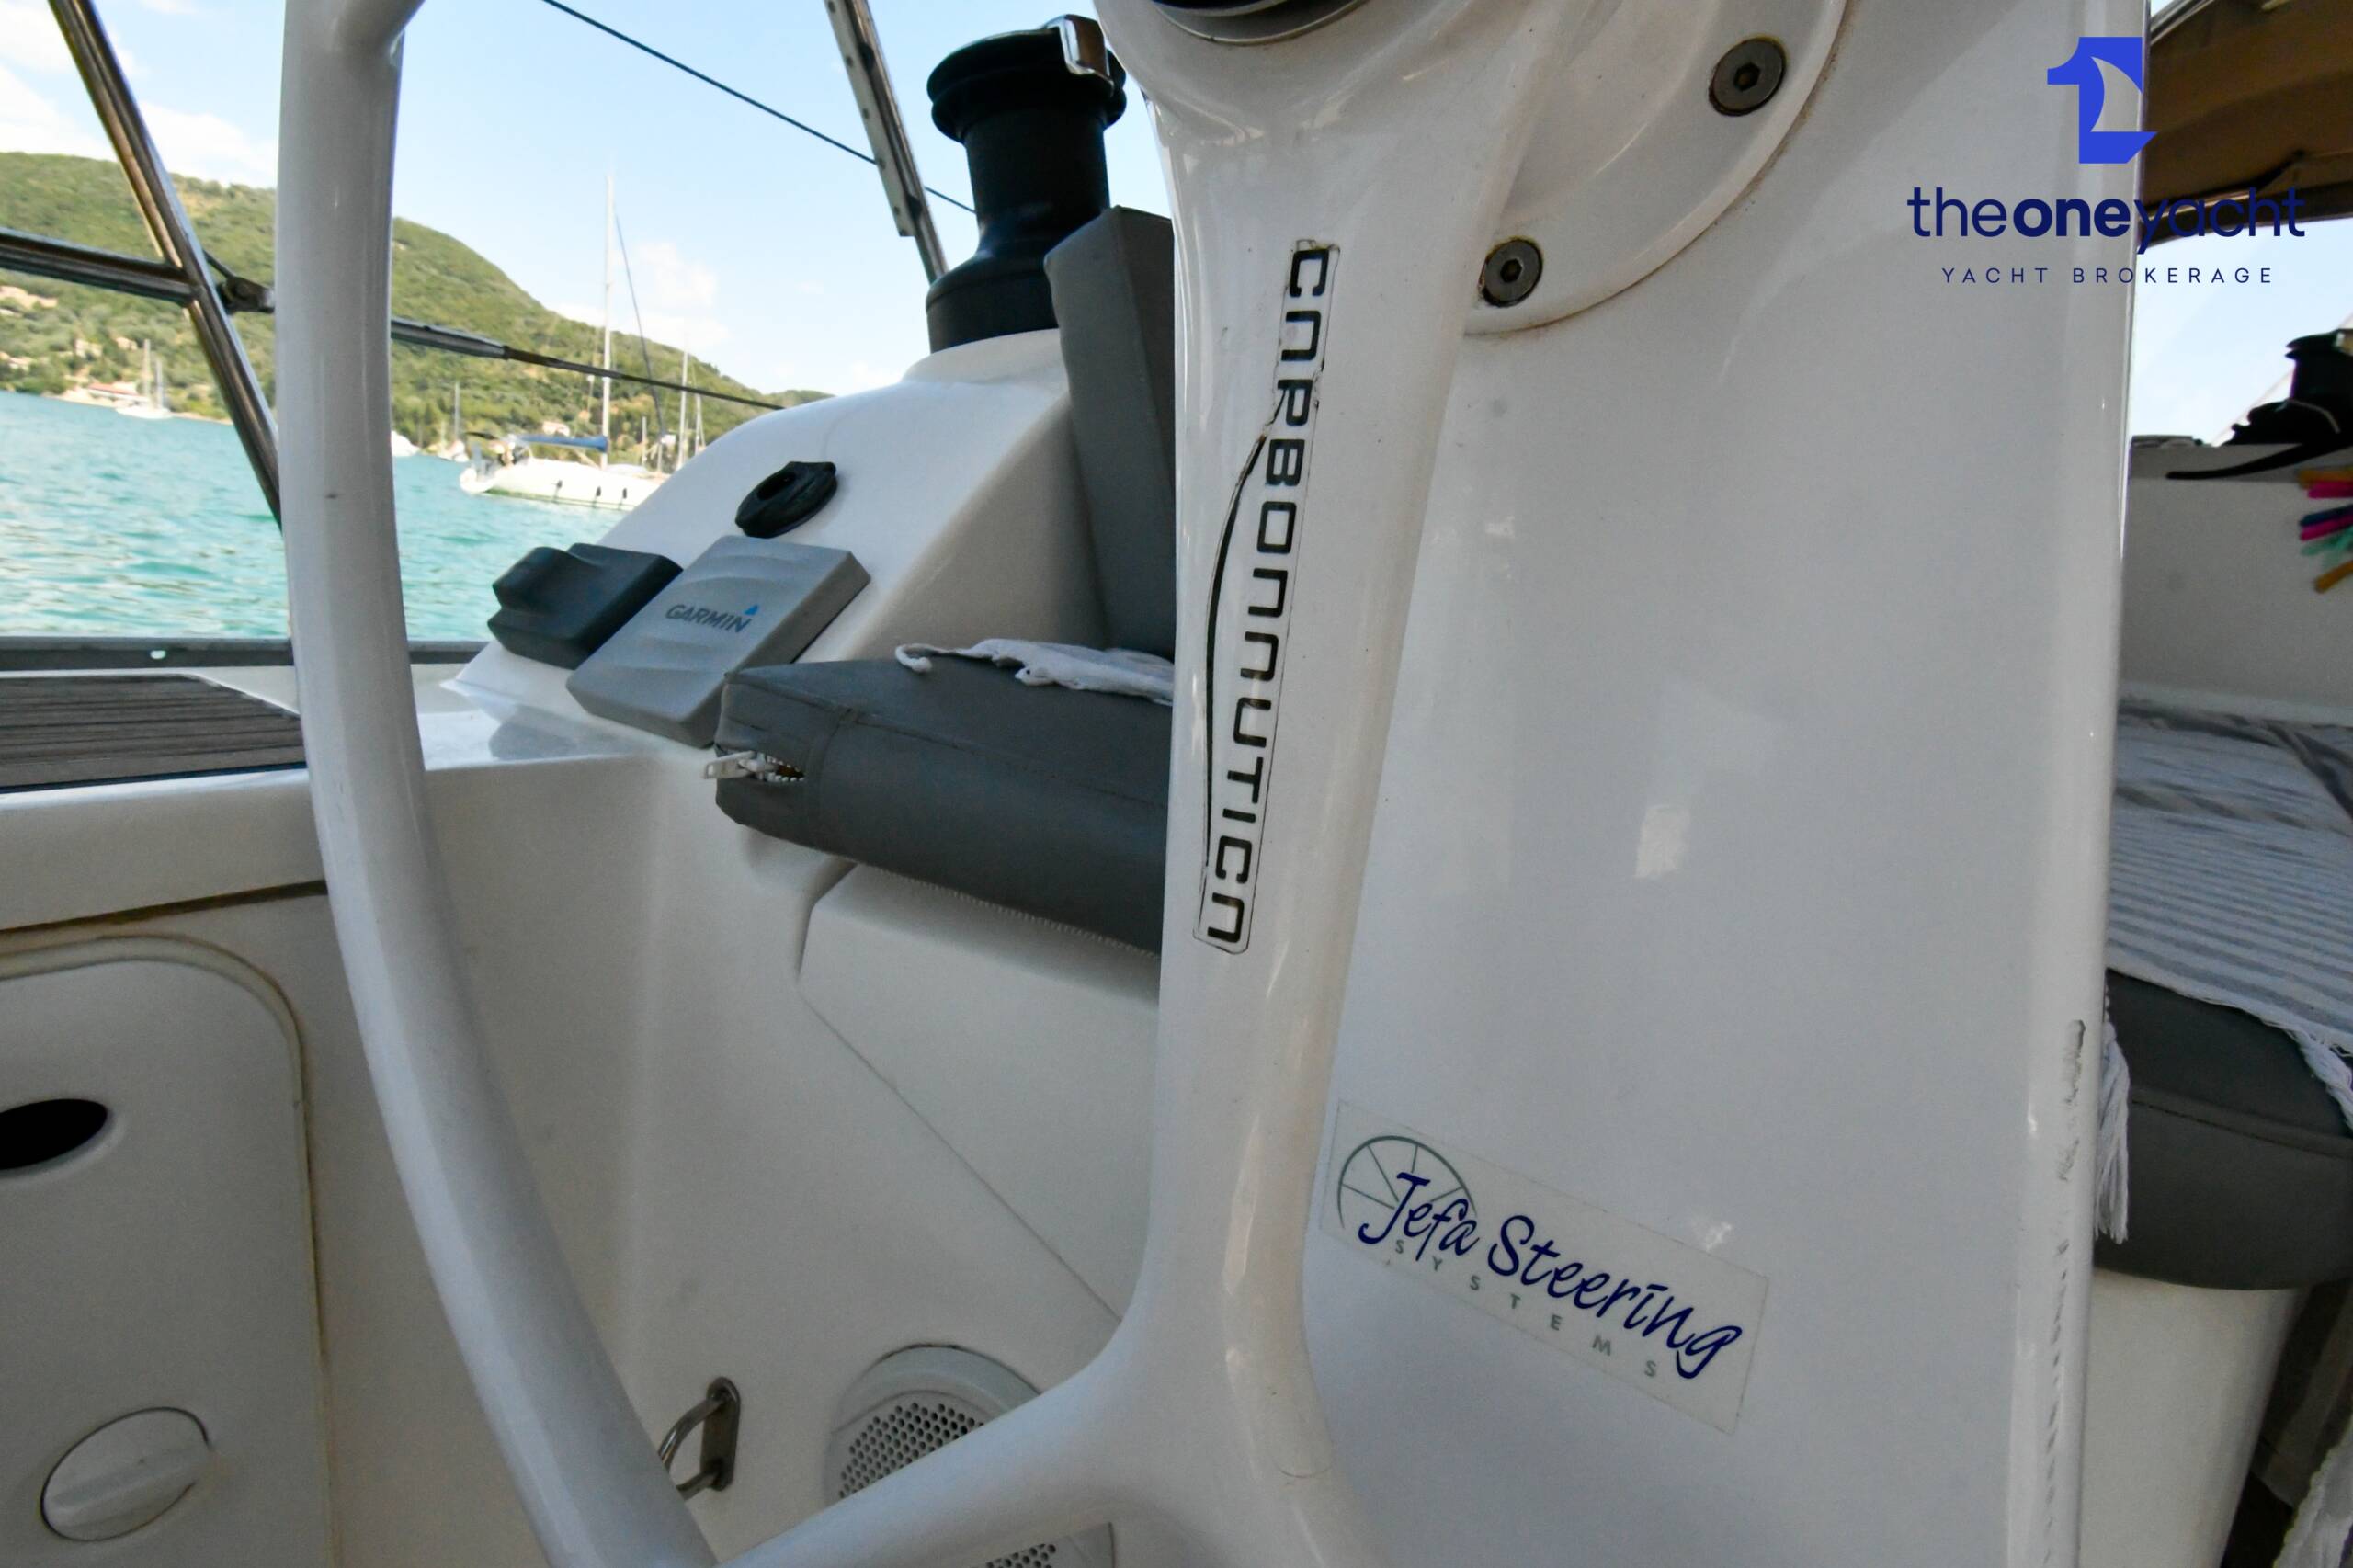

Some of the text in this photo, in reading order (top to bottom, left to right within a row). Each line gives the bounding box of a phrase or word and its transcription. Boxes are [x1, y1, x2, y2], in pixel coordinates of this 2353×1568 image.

[665, 604, 752, 632] GARMIN
[1358, 1172, 1743, 1380] Jefa Steering
[1394, 1239, 1657, 1378] SYSTEMS
